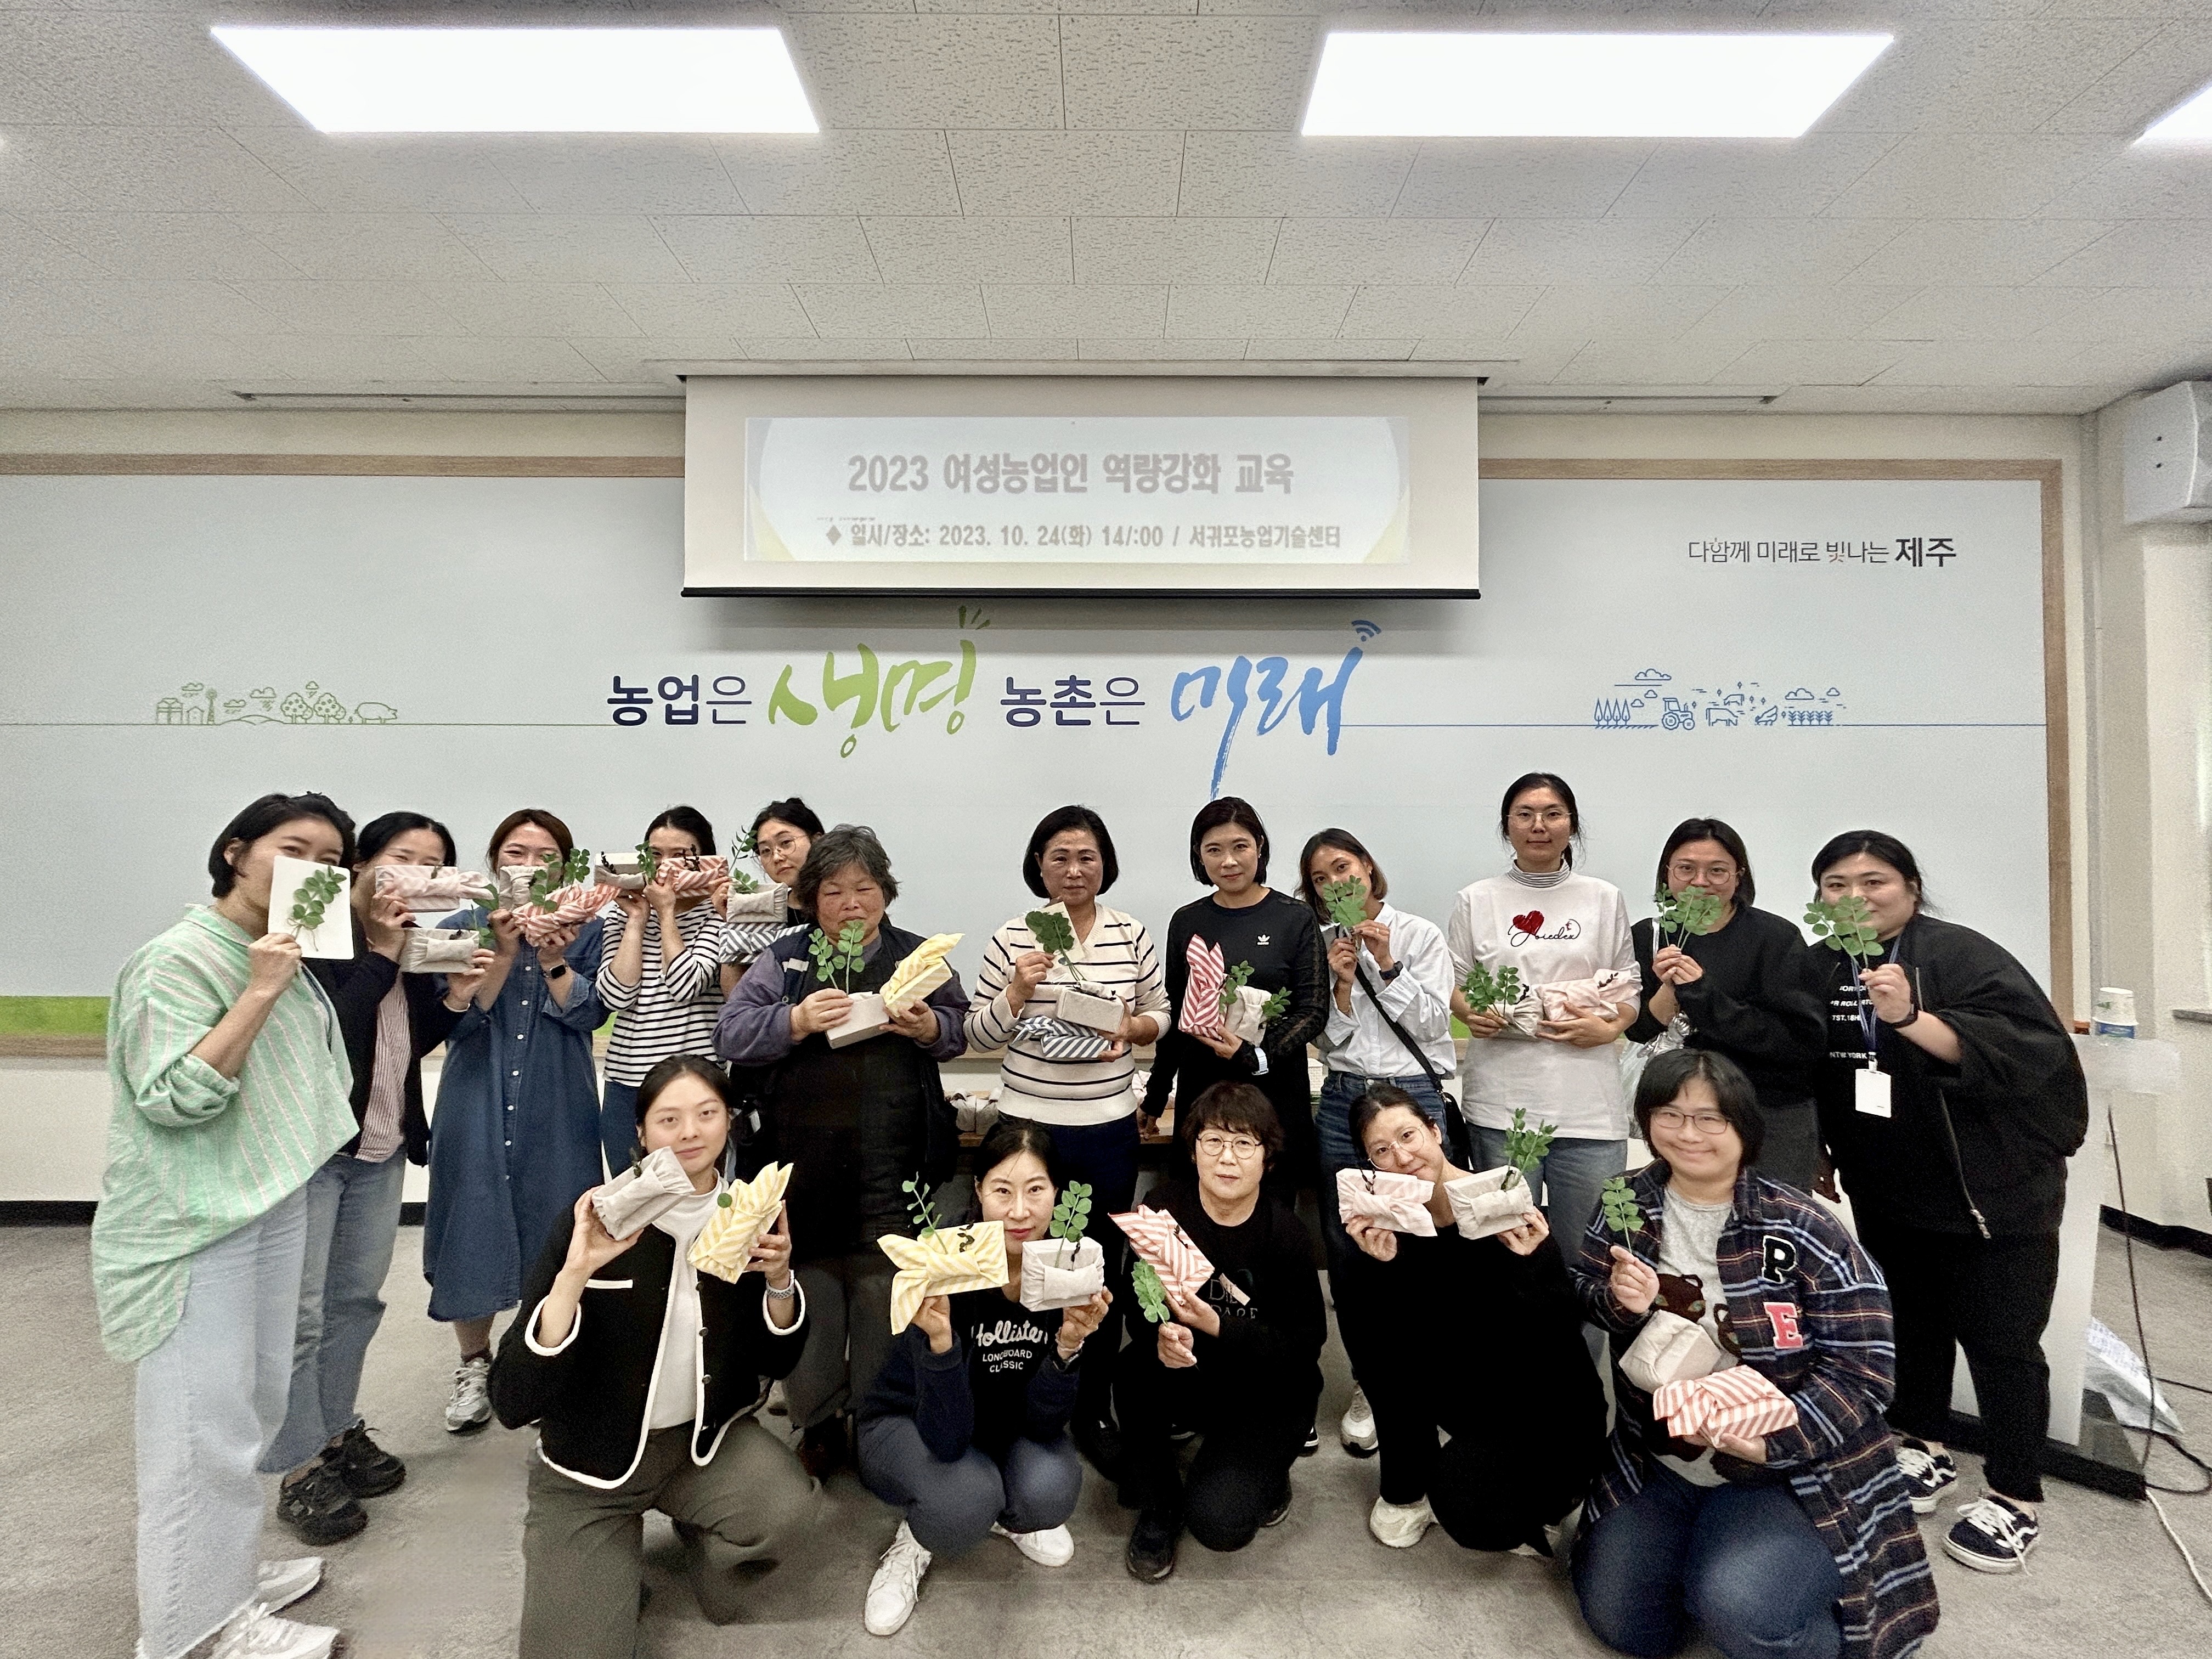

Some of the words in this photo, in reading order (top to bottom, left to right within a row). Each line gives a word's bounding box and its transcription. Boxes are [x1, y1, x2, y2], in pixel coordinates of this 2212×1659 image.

[848, 454, 929, 493] 2023
[943, 453, 1087, 494] 여성농업인
[1103, 453, 1222, 494] 역량강화
[1234, 453, 1294, 494] 교육
[850, 523, 930, 547] 일시/장소:
[939, 524, 990, 546] 2023.
[1001, 524, 1028, 546] 10.
[1037, 524, 1092, 547] 24(화)
[1189, 524, 1341, 548] 서귀포농업기술센터
[1689, 538, 1750, 563] 다함께
[1757, 540, 1821, 563] 미래로
[1826, 541, 1890, 563] 빛나는
[1894, 537, 1957, 567] 제주
[607, 674, 753, 726] 농업은
[768, 639, 977, 759] 생명
[1000, 675, 1146, 727] 농촌은
[1170, 646, 1364, 803] 미래
[1762, 1234, 1797, 1283] P
[1763, 1301, 1804, 1350] E
